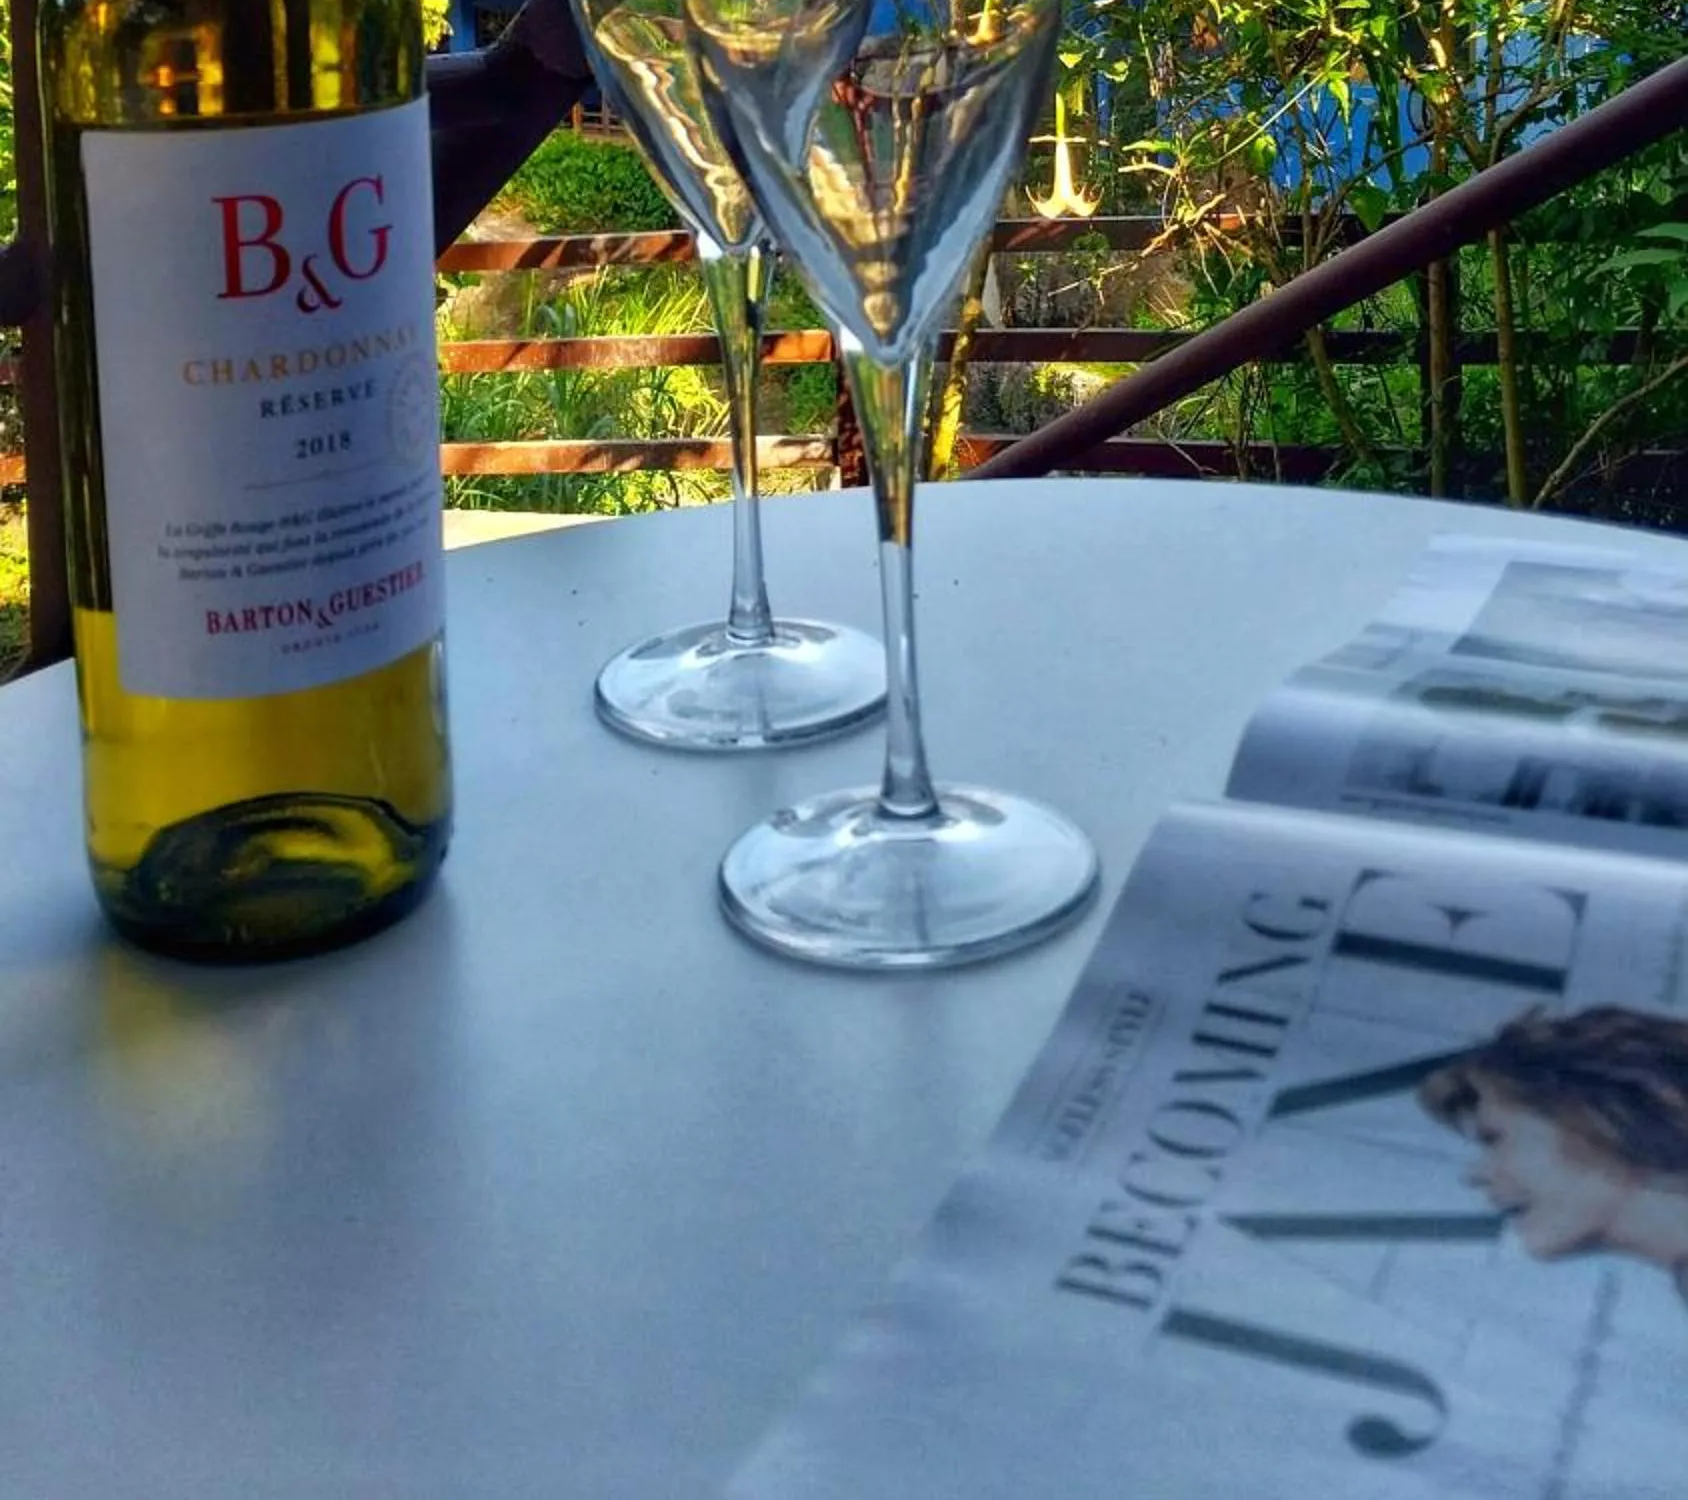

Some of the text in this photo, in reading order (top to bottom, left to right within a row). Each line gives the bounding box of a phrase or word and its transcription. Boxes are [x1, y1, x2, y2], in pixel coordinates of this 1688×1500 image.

[211, 174, 393, 314] B&G
[260, 379, 376, 419] RÉSERVE
[296, 431, 353, 460] 2018
[1056, 893, 1329, 1312] BECOMING
